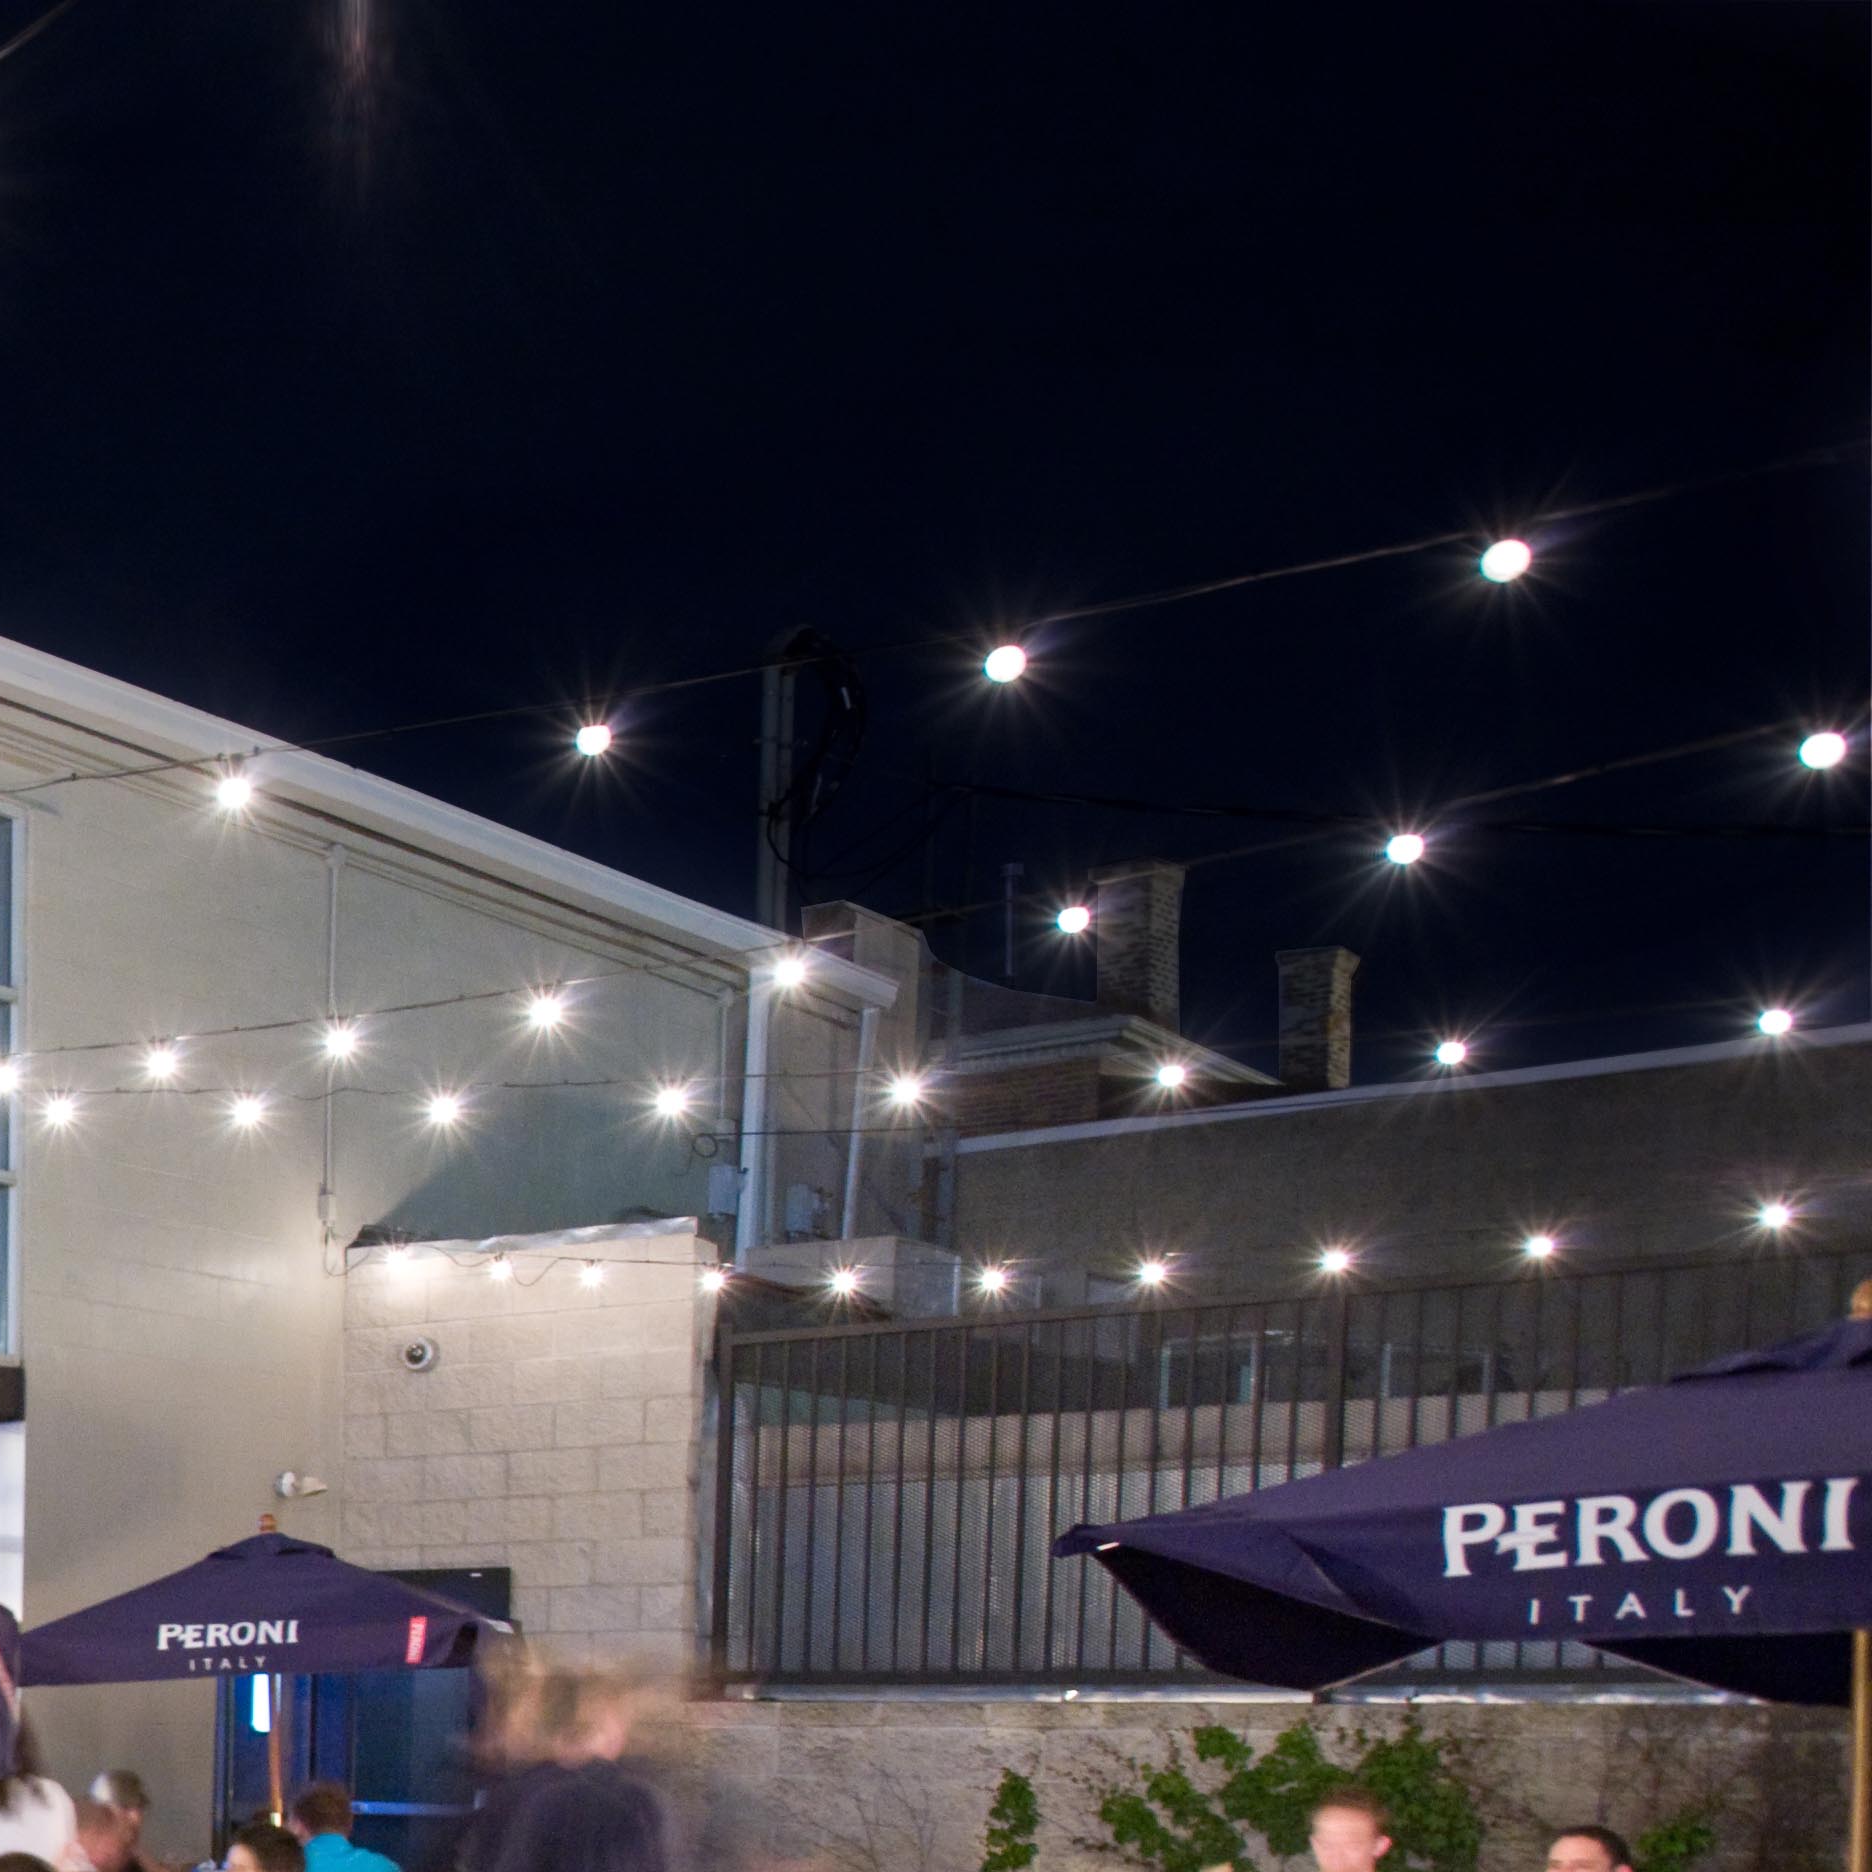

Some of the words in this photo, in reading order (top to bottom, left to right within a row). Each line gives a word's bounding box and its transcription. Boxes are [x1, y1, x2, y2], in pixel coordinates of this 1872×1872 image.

[1442, 1477, 1859, 1577] PERONI
[1528, 1584, 1753, 1625] ITALY
[156, 1619, 300, 1651] PERONI
[188, 1655, 267, 1671] ITALY
